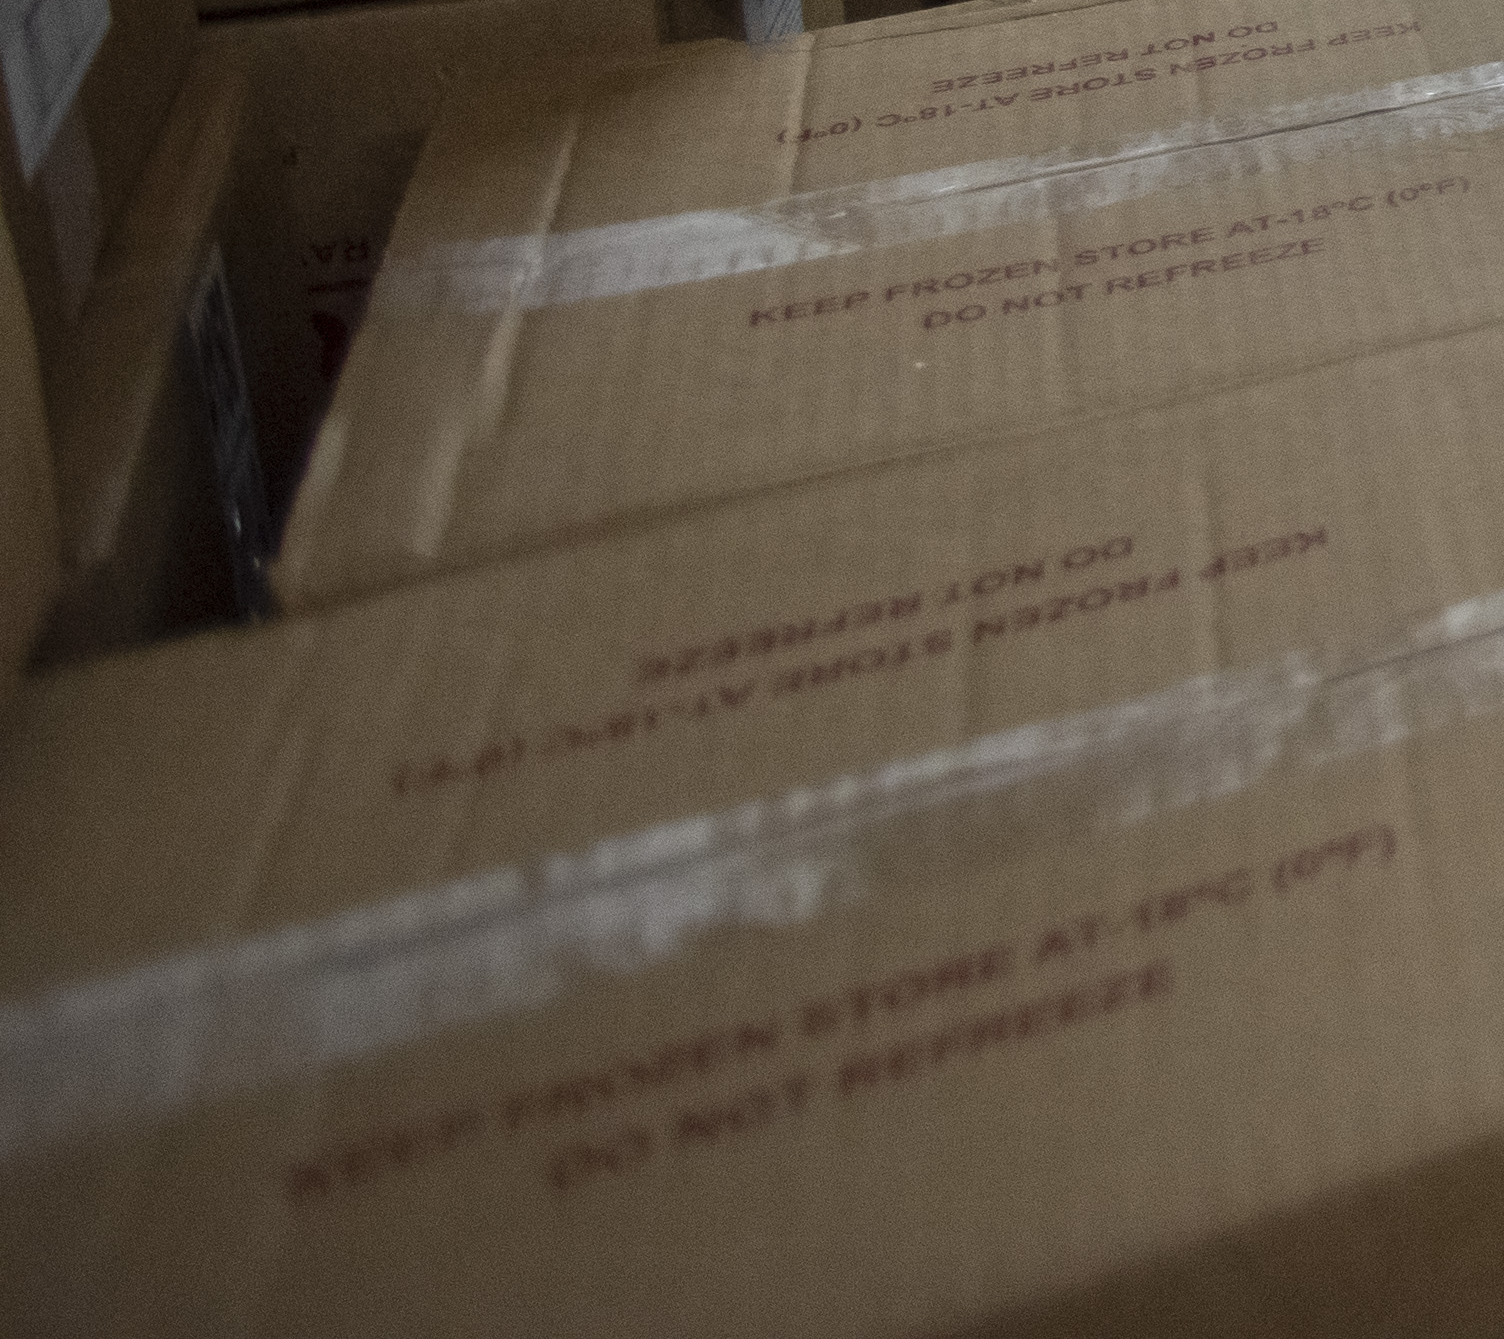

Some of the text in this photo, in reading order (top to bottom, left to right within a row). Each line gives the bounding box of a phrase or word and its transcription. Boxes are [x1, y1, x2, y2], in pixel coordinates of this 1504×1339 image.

[930, 20, 1281, 94] DO NOT REFREEZE
[1169, 37, 1318, 76] FROZEN
[1327, 21, 1423, 49] KEEP
[1029, 65, 1158, 104] STORE
[748, 289, 870, 328] KEEP
[883, 256, 1059, 304] FROZEN
[1074, 224, 1216, 269] STORE
[920, 235, 1326, 331] DO NOT REFREEZE
[1200, 527, 1330, 581] KEEP
[636, 535, 1134, 685] DO NOT REFREEZE
[971, 566, 1181, 646] FROZEN
[770, 625, 955, 697] STORE
[503, 1019, 778, 1131] FROZEN
[801, 948, 1010, 1036] STORE
[543, 959, 1175, 1191] DO NOT REFREEZE
